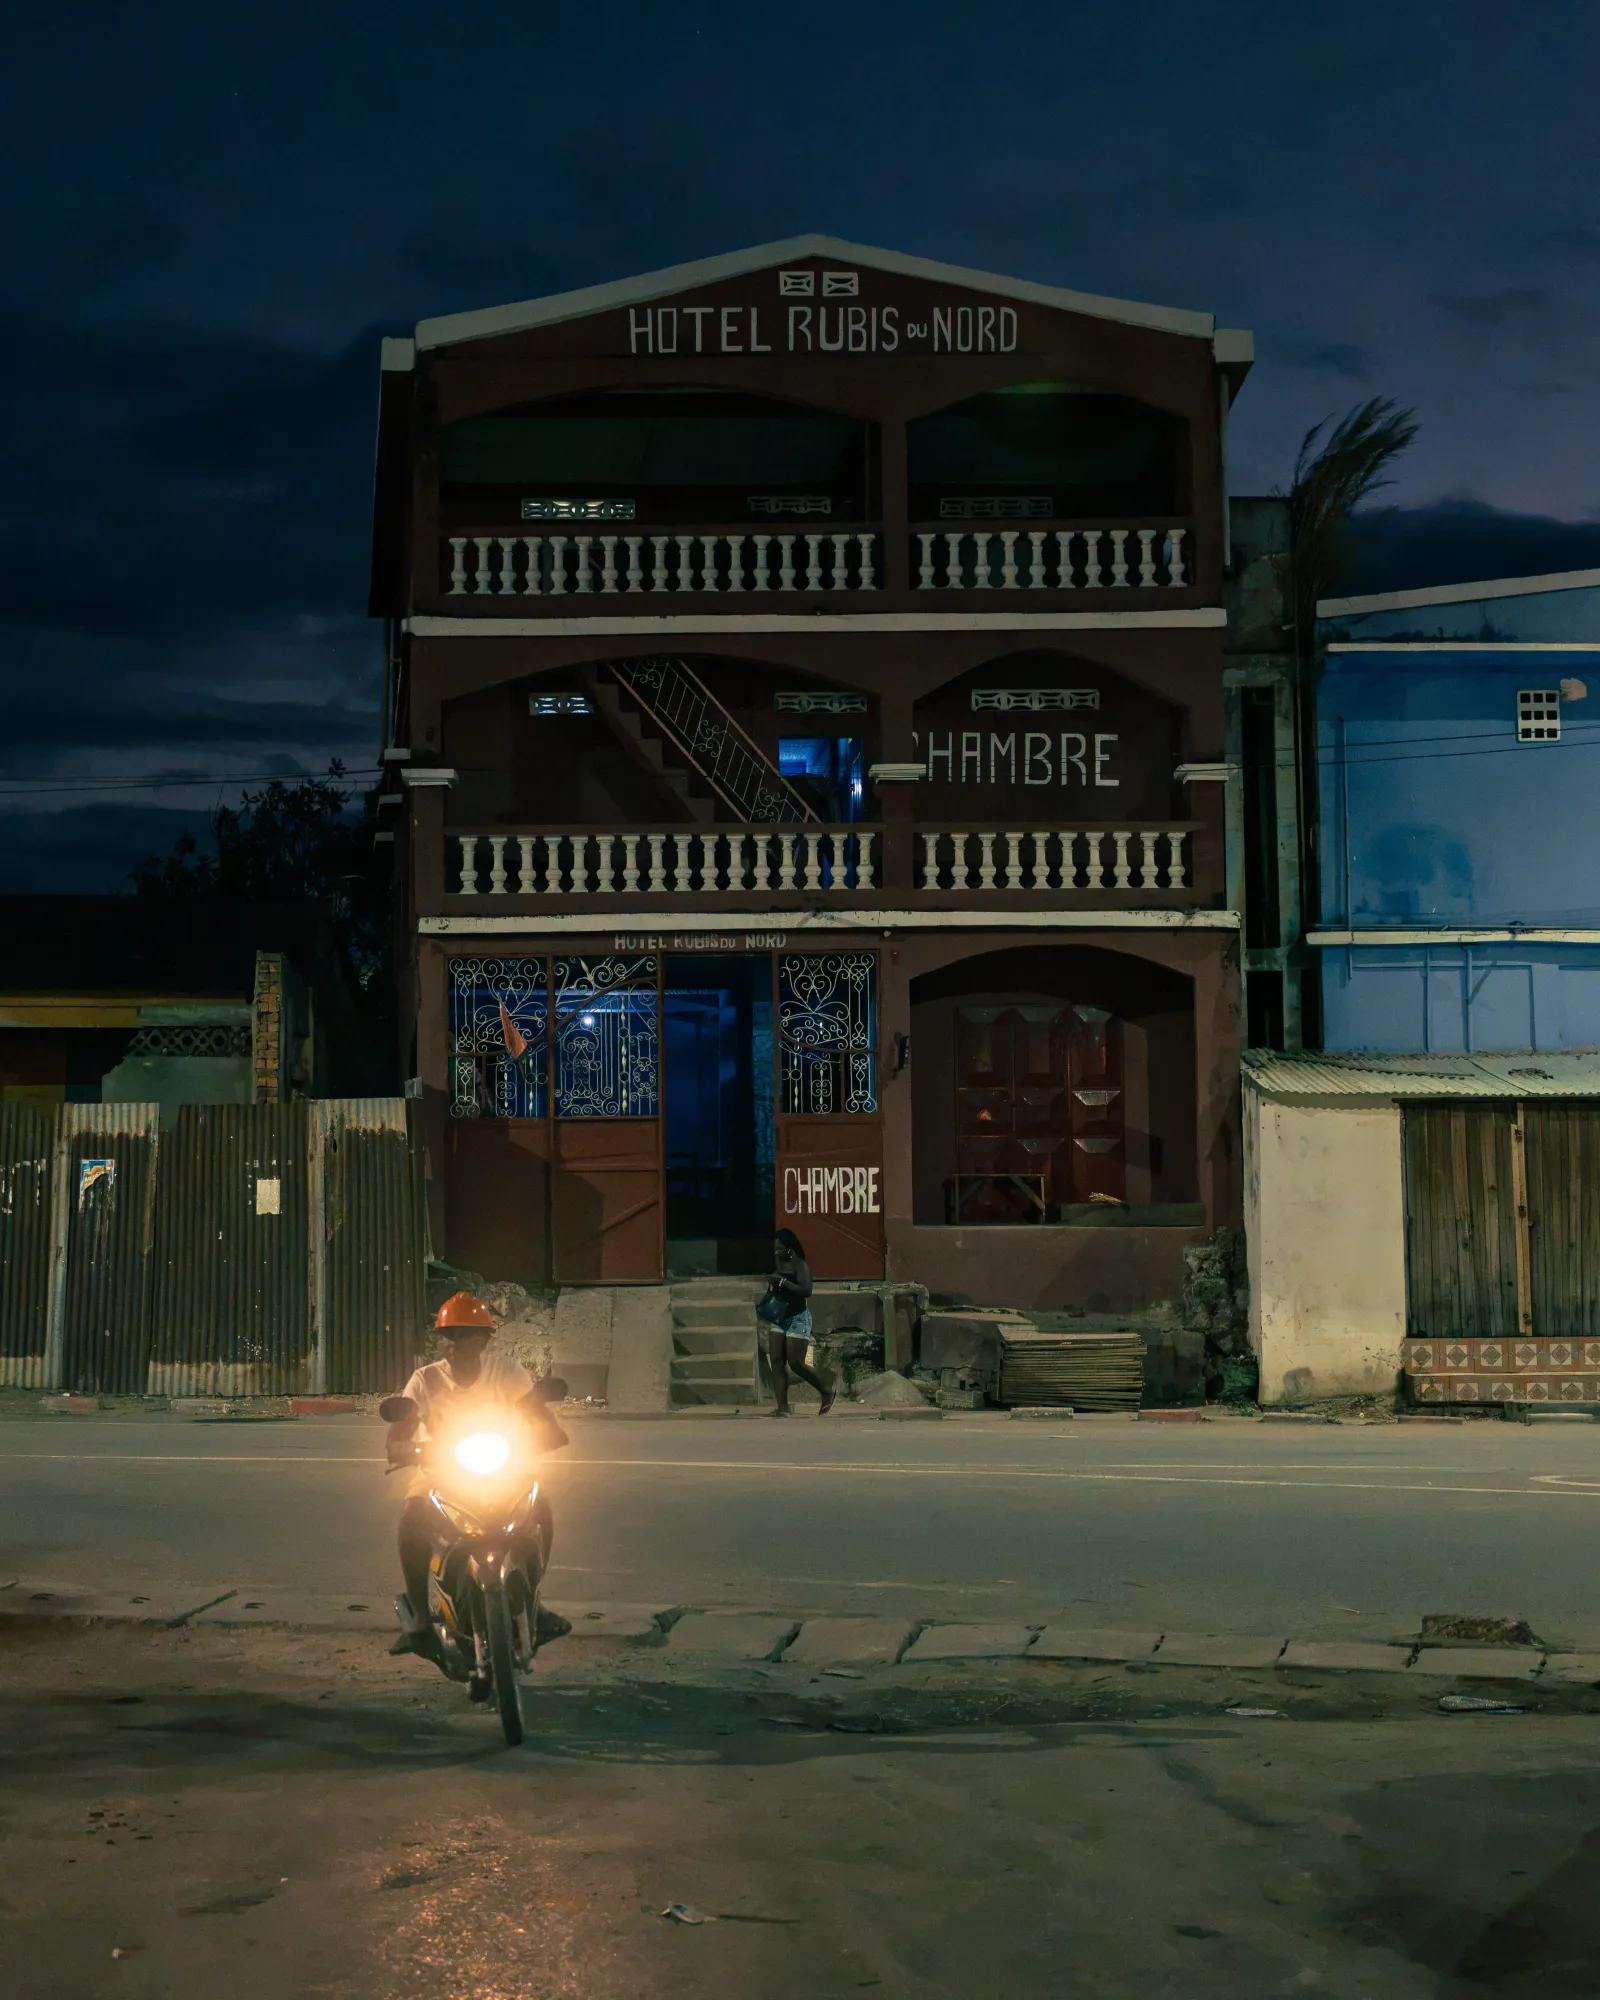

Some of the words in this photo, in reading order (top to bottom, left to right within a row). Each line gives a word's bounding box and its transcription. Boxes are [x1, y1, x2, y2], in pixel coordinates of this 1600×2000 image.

[628, 306, 771, 354] HOTEL
[788, 306, 899, 353] RUBIS
[906, 322, 928, 339] DU
[932, 306, 1018, 353] NORD
[912, 731, 1120, 787] HAMBRE
[614, 933, 667, 950] HOTEL
[673, 932, 719, 949] RUBIS
[745, 932, 787, 949] NORD
[784, 1166, 880, 1214] CHAMBRE
